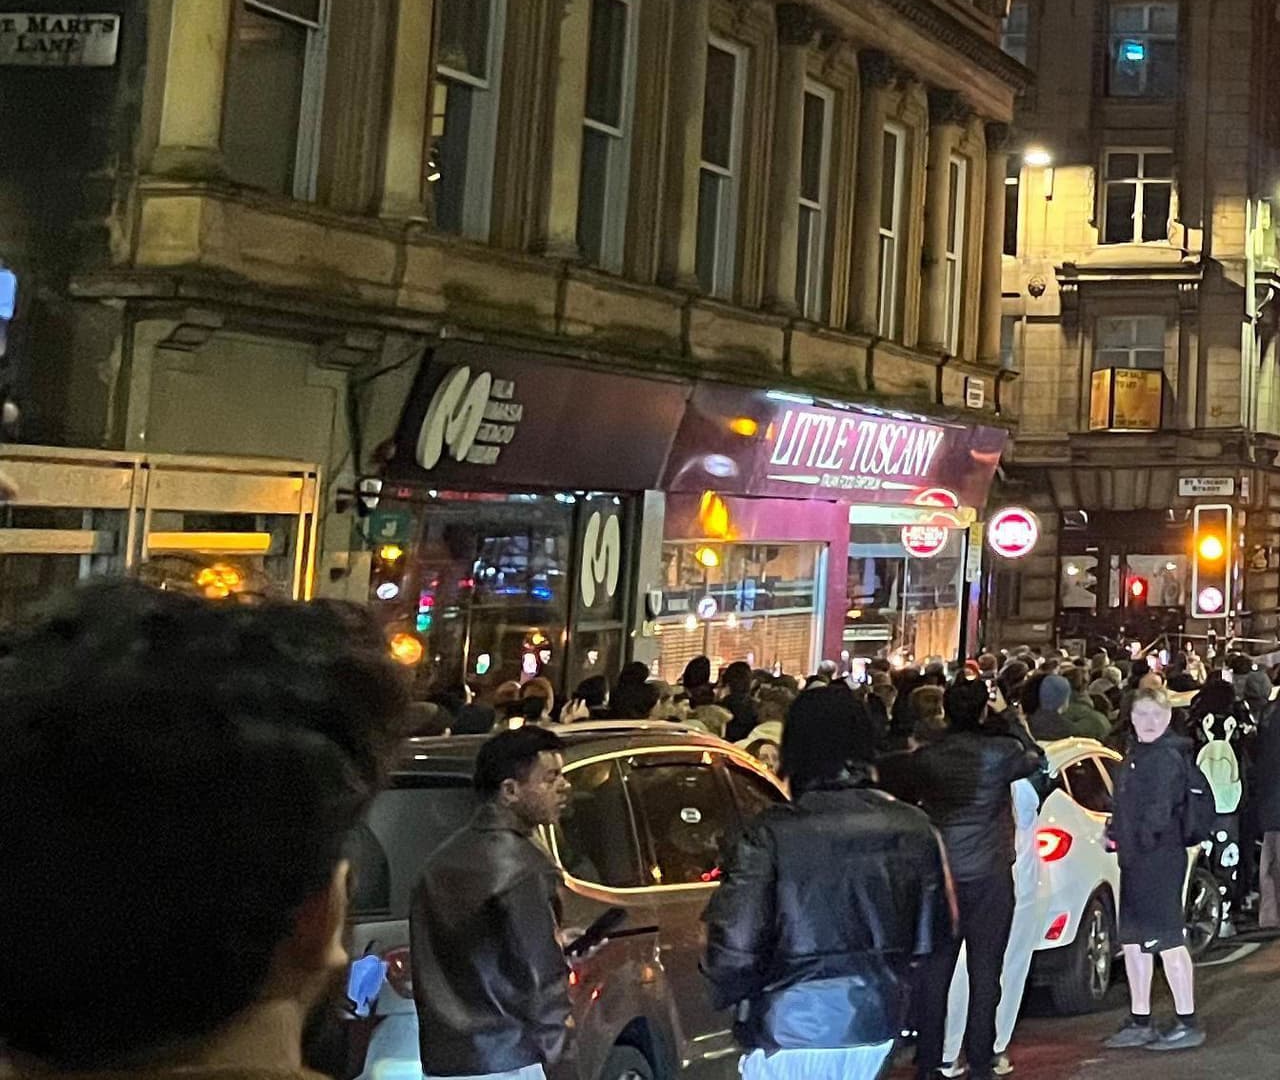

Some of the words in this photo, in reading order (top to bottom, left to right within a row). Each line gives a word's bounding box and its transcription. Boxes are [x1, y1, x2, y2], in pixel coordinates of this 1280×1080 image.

[16, 34, 79, 53] LANE
[770, 410, 855, 469] LITTLE
[850, 420, 944, 477] TUSCANY
